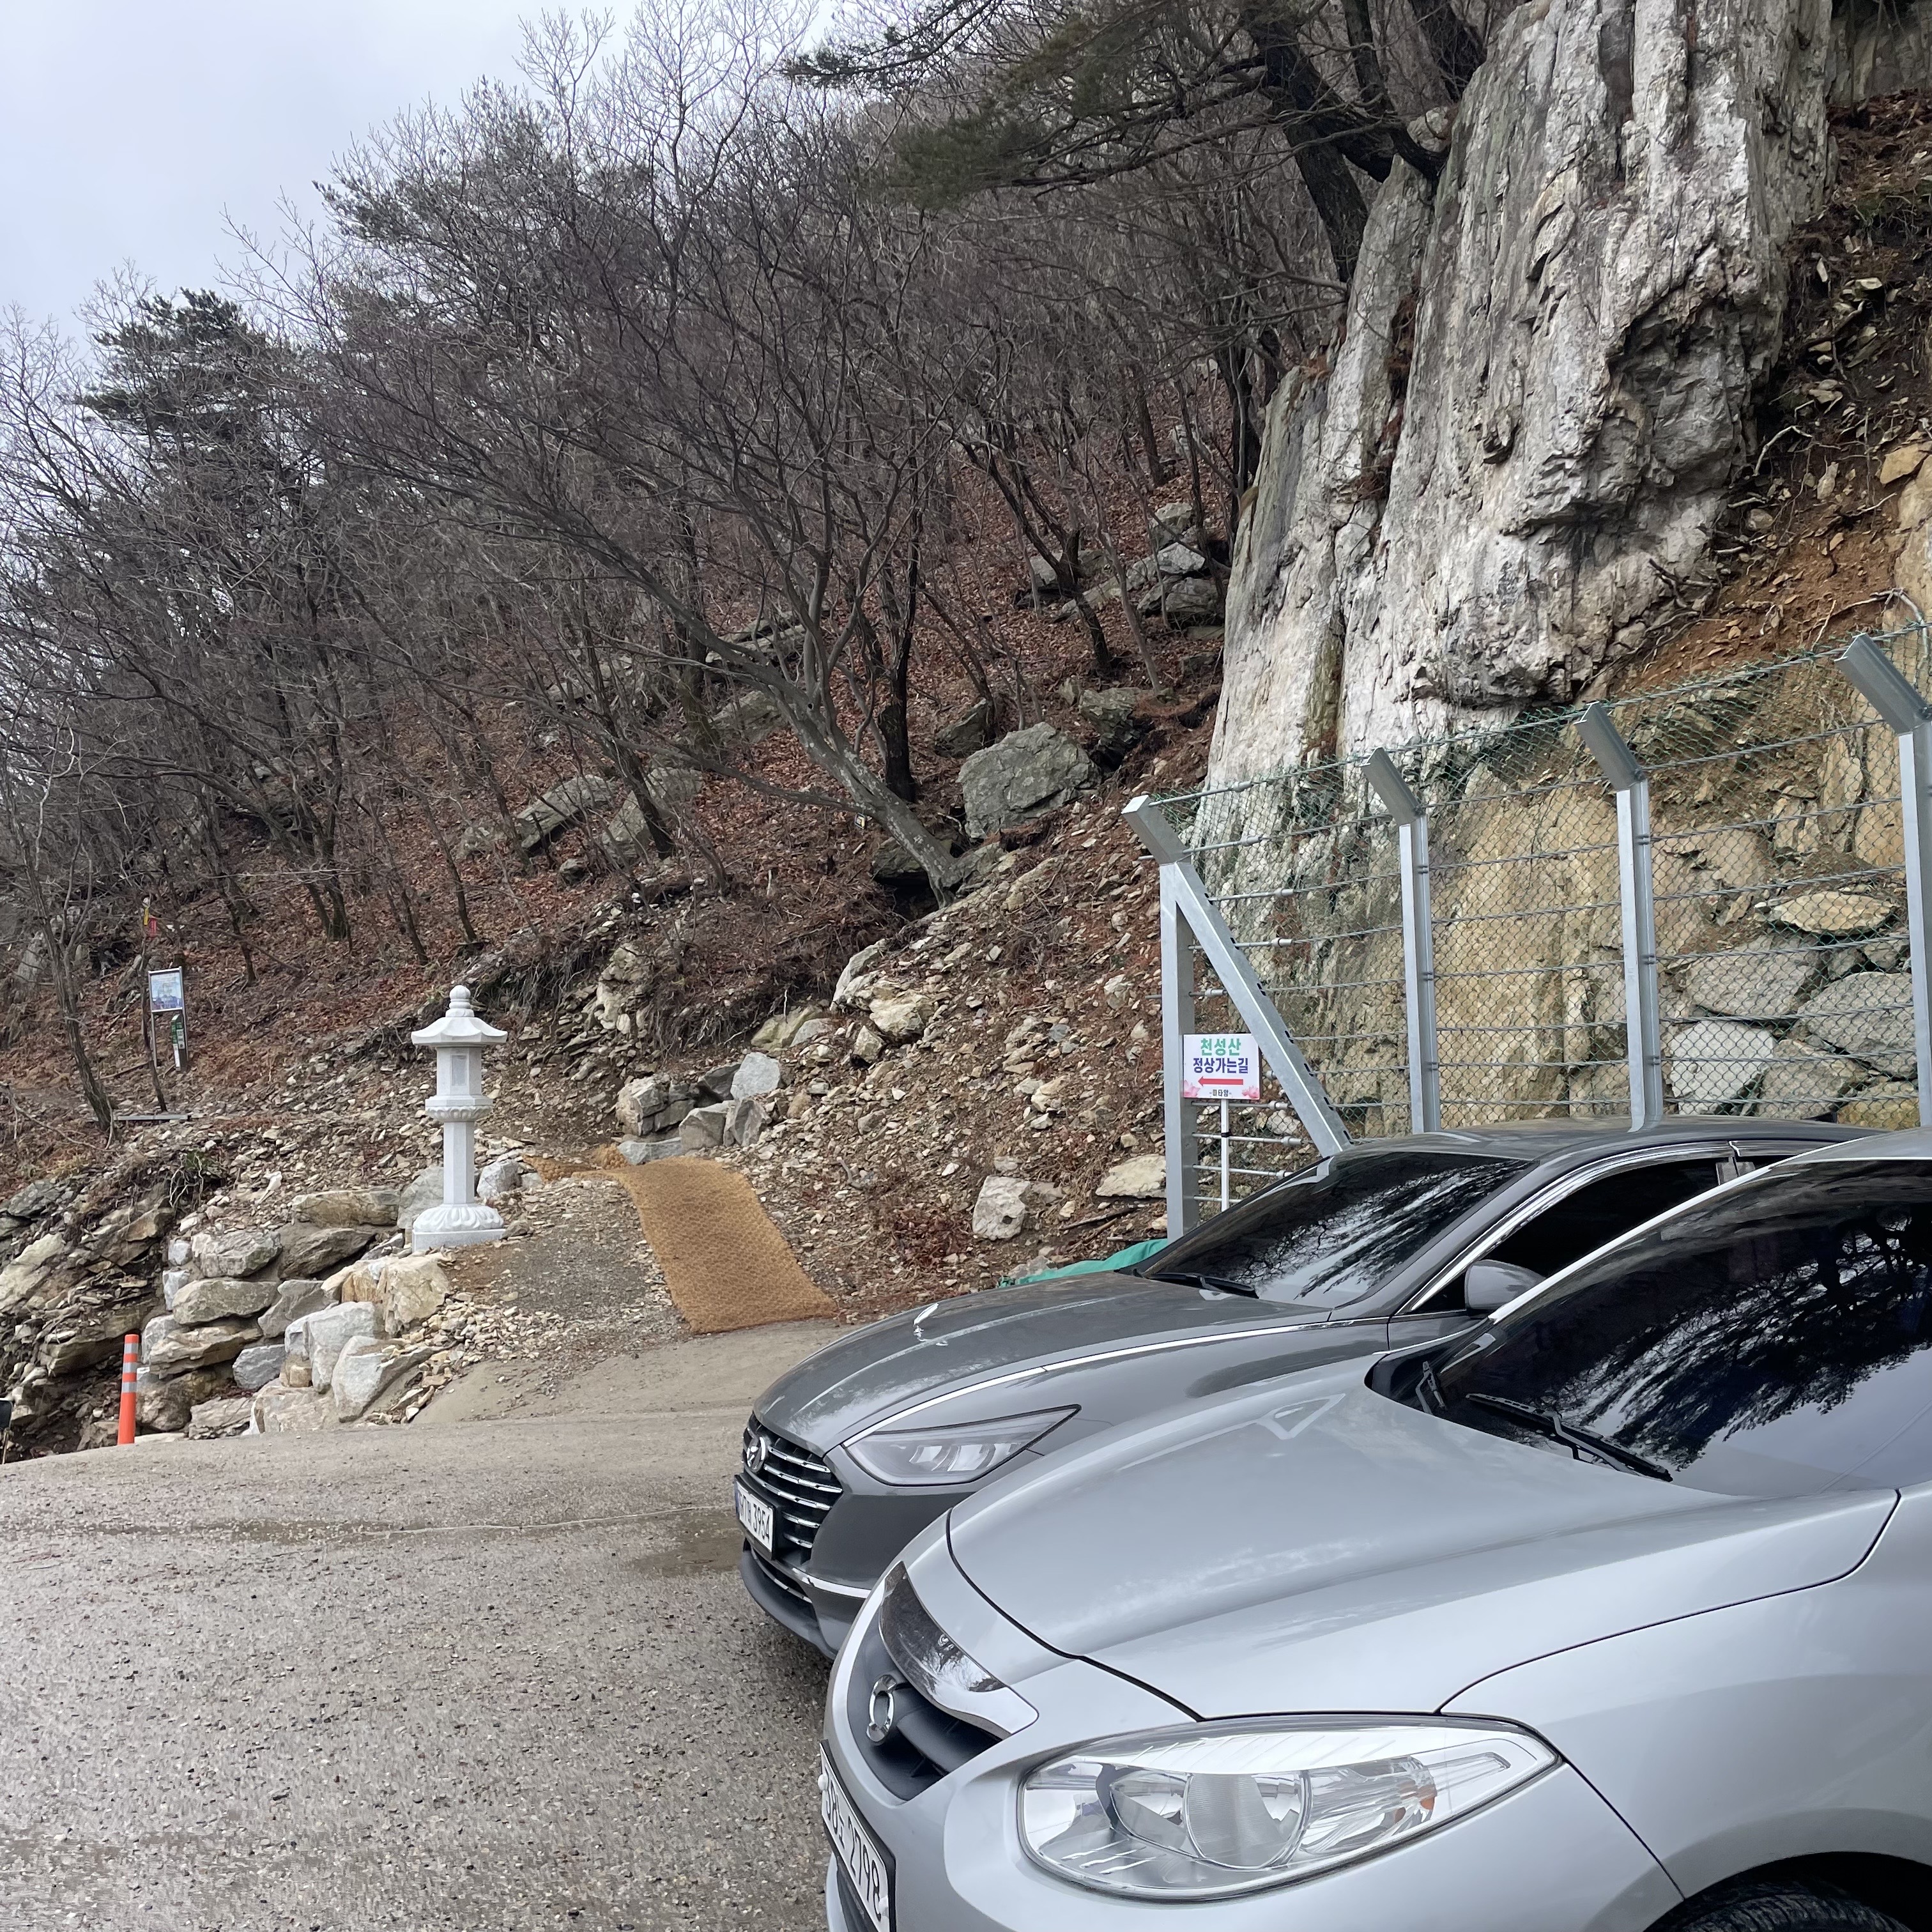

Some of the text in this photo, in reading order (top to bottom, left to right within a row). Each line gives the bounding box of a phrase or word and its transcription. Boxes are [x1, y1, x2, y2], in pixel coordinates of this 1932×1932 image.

[1200, 1038, 1241, 1056] 천성산
[1193, 1057, 1248, 1074] 정상가는길
[753, 1503, 770, 1544] 3954
[847, 1814, 882, 1922] 2798
